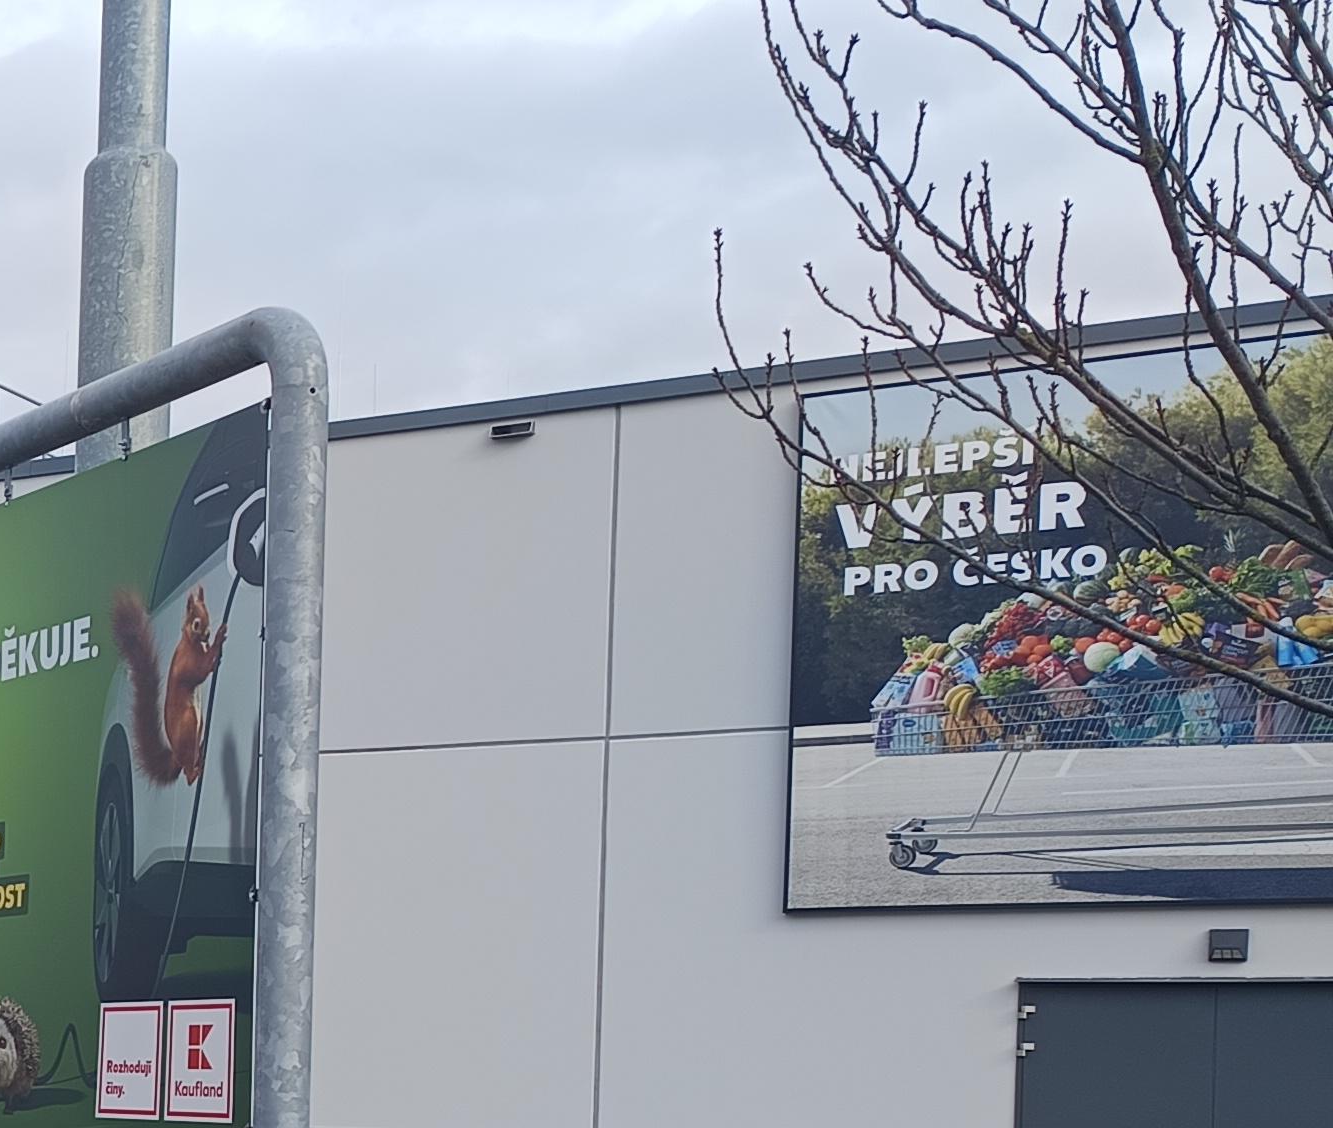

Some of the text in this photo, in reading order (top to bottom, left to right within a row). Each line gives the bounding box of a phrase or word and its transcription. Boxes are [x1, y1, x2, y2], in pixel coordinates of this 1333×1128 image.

[835, 472, 1088, 549] VÝBĚR
[843, 545, 1108, 597] PRO ČESKO
[106, 1060, 152, 1077] Rozhodují
[106, 1082, 125, 1098] činy.
[174, 1081, 223, 1098] Kaufland
